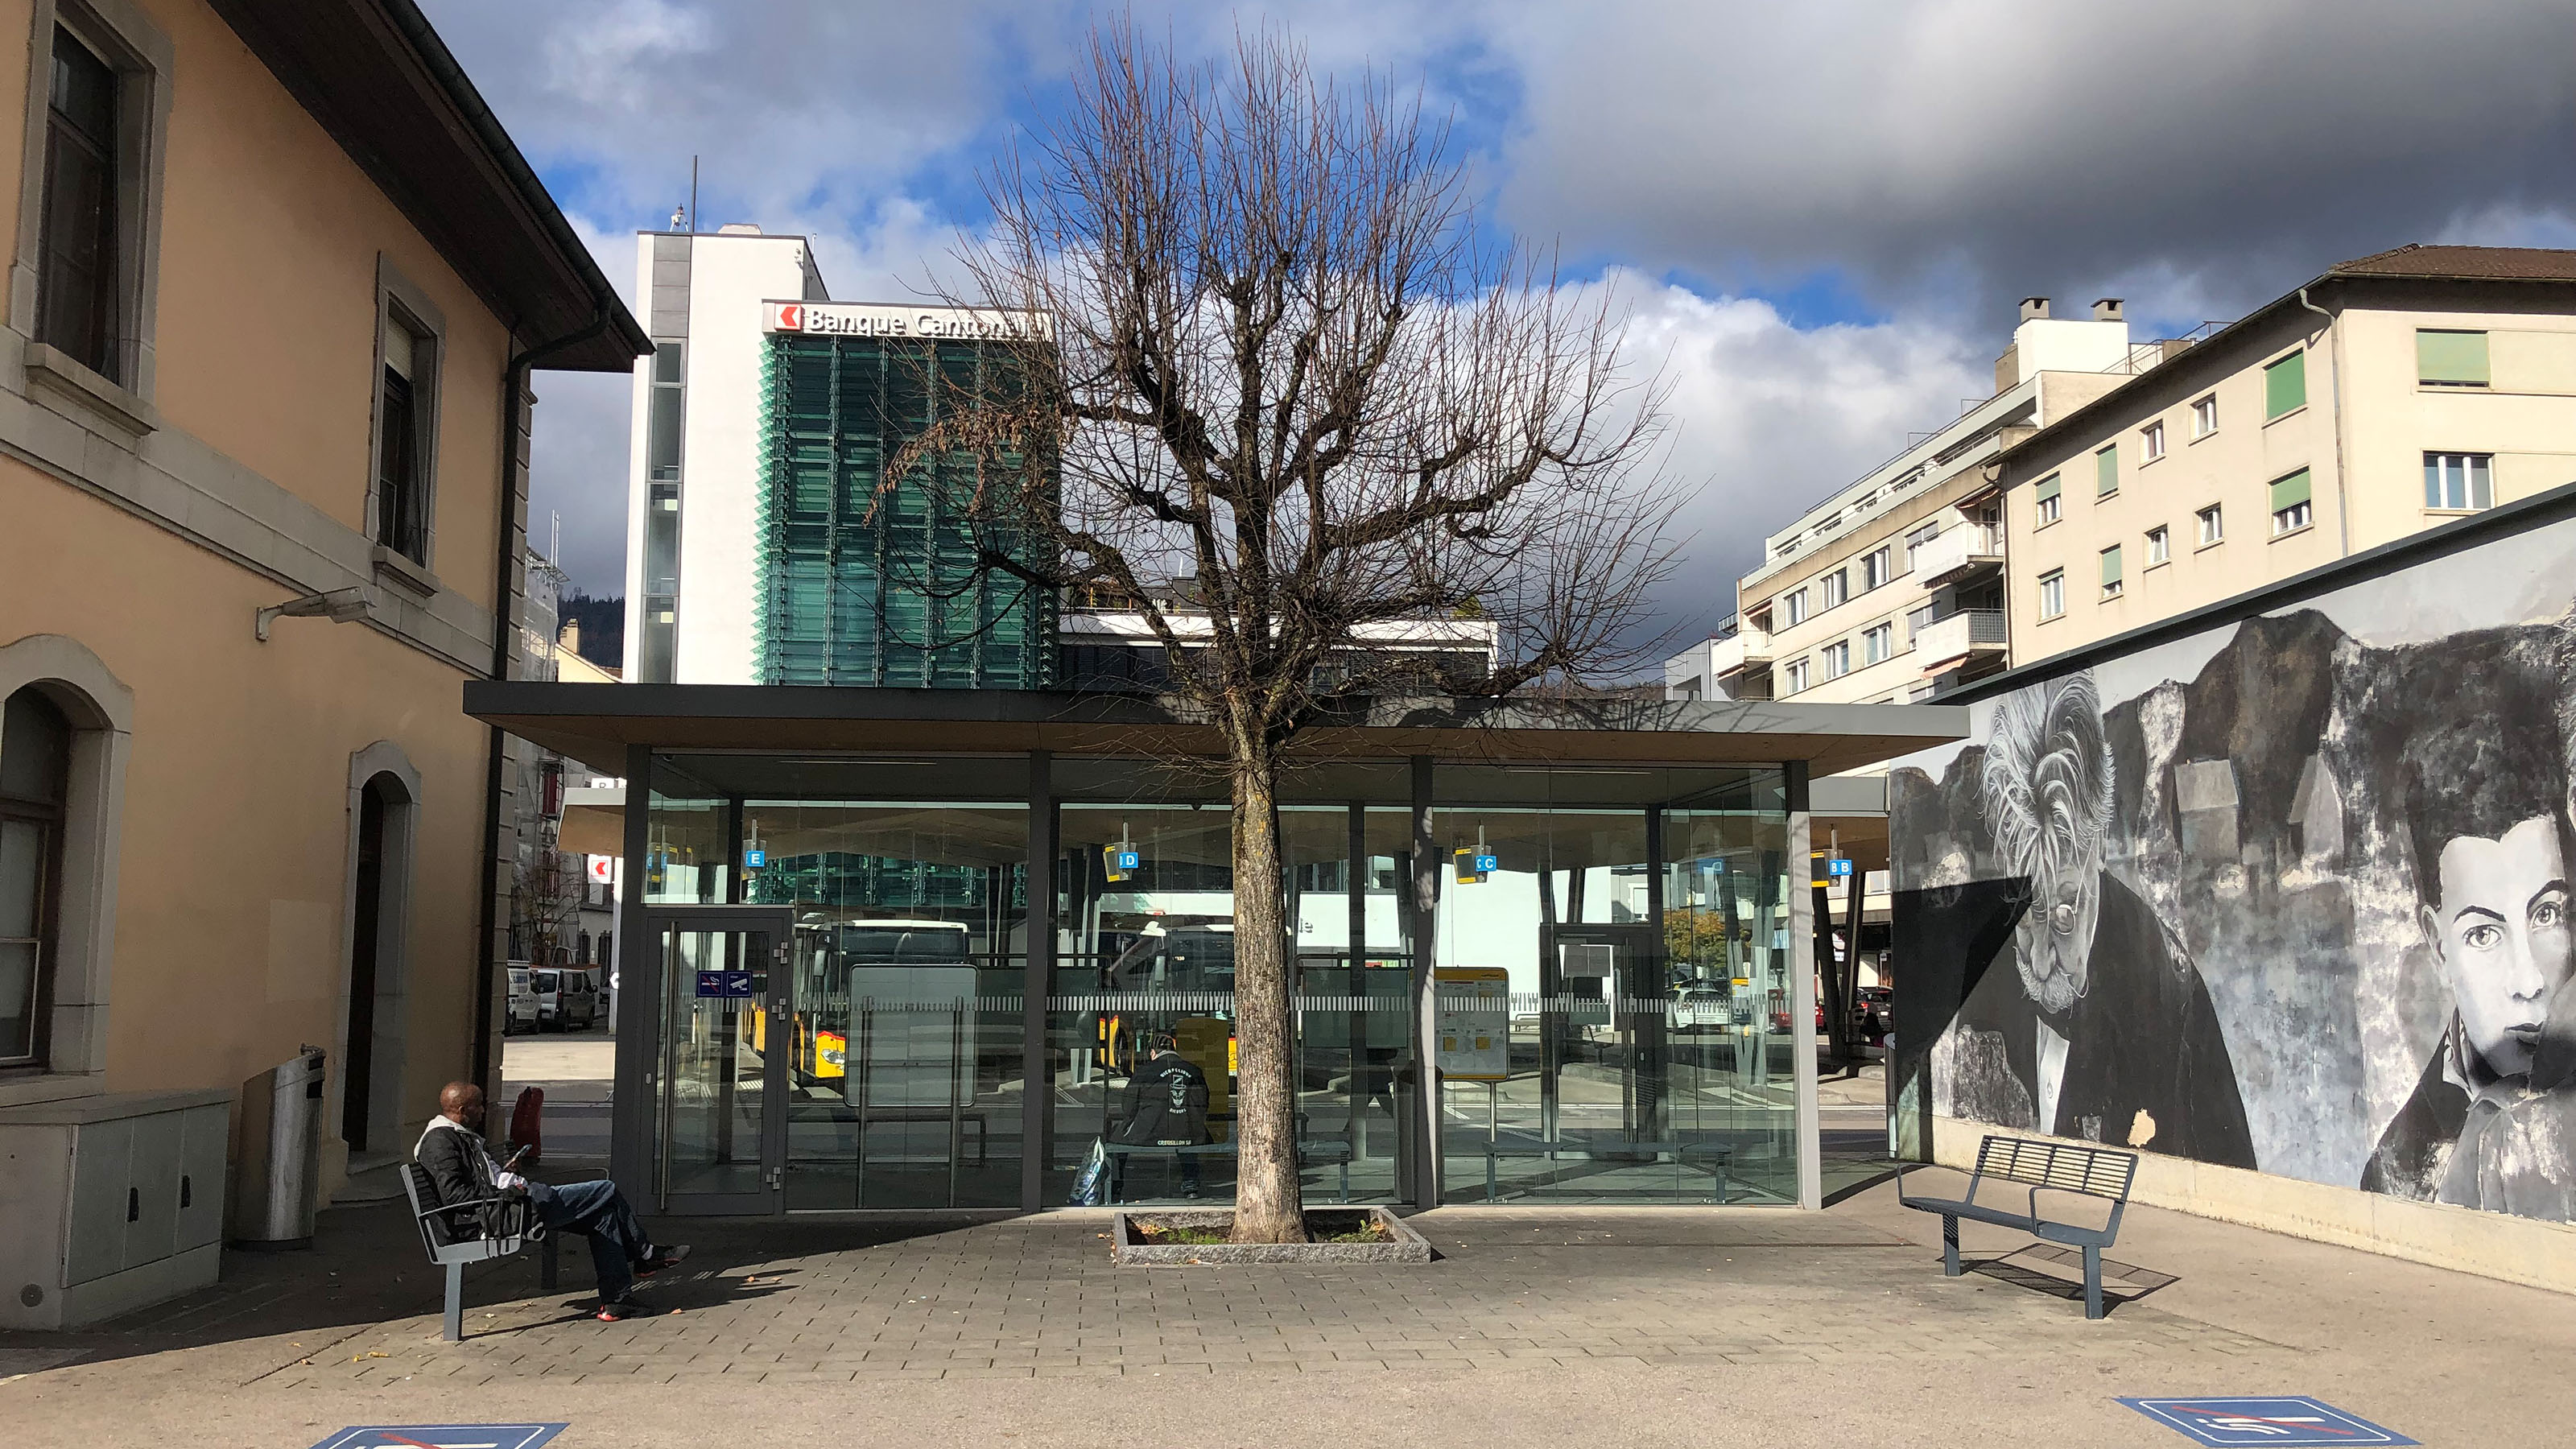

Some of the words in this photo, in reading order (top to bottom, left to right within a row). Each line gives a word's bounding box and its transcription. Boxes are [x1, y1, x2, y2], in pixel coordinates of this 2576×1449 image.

[810, 309, 906, 336] Banque
[751, 853, 761, 864] E
[1126, 855, 1135, 865] D
[1477, 858, 1482, 869] C
[1485, 858, 1494, 869] C
[1831, 862, 1838, 873] B
[1841, 862, 1849, 873] B
